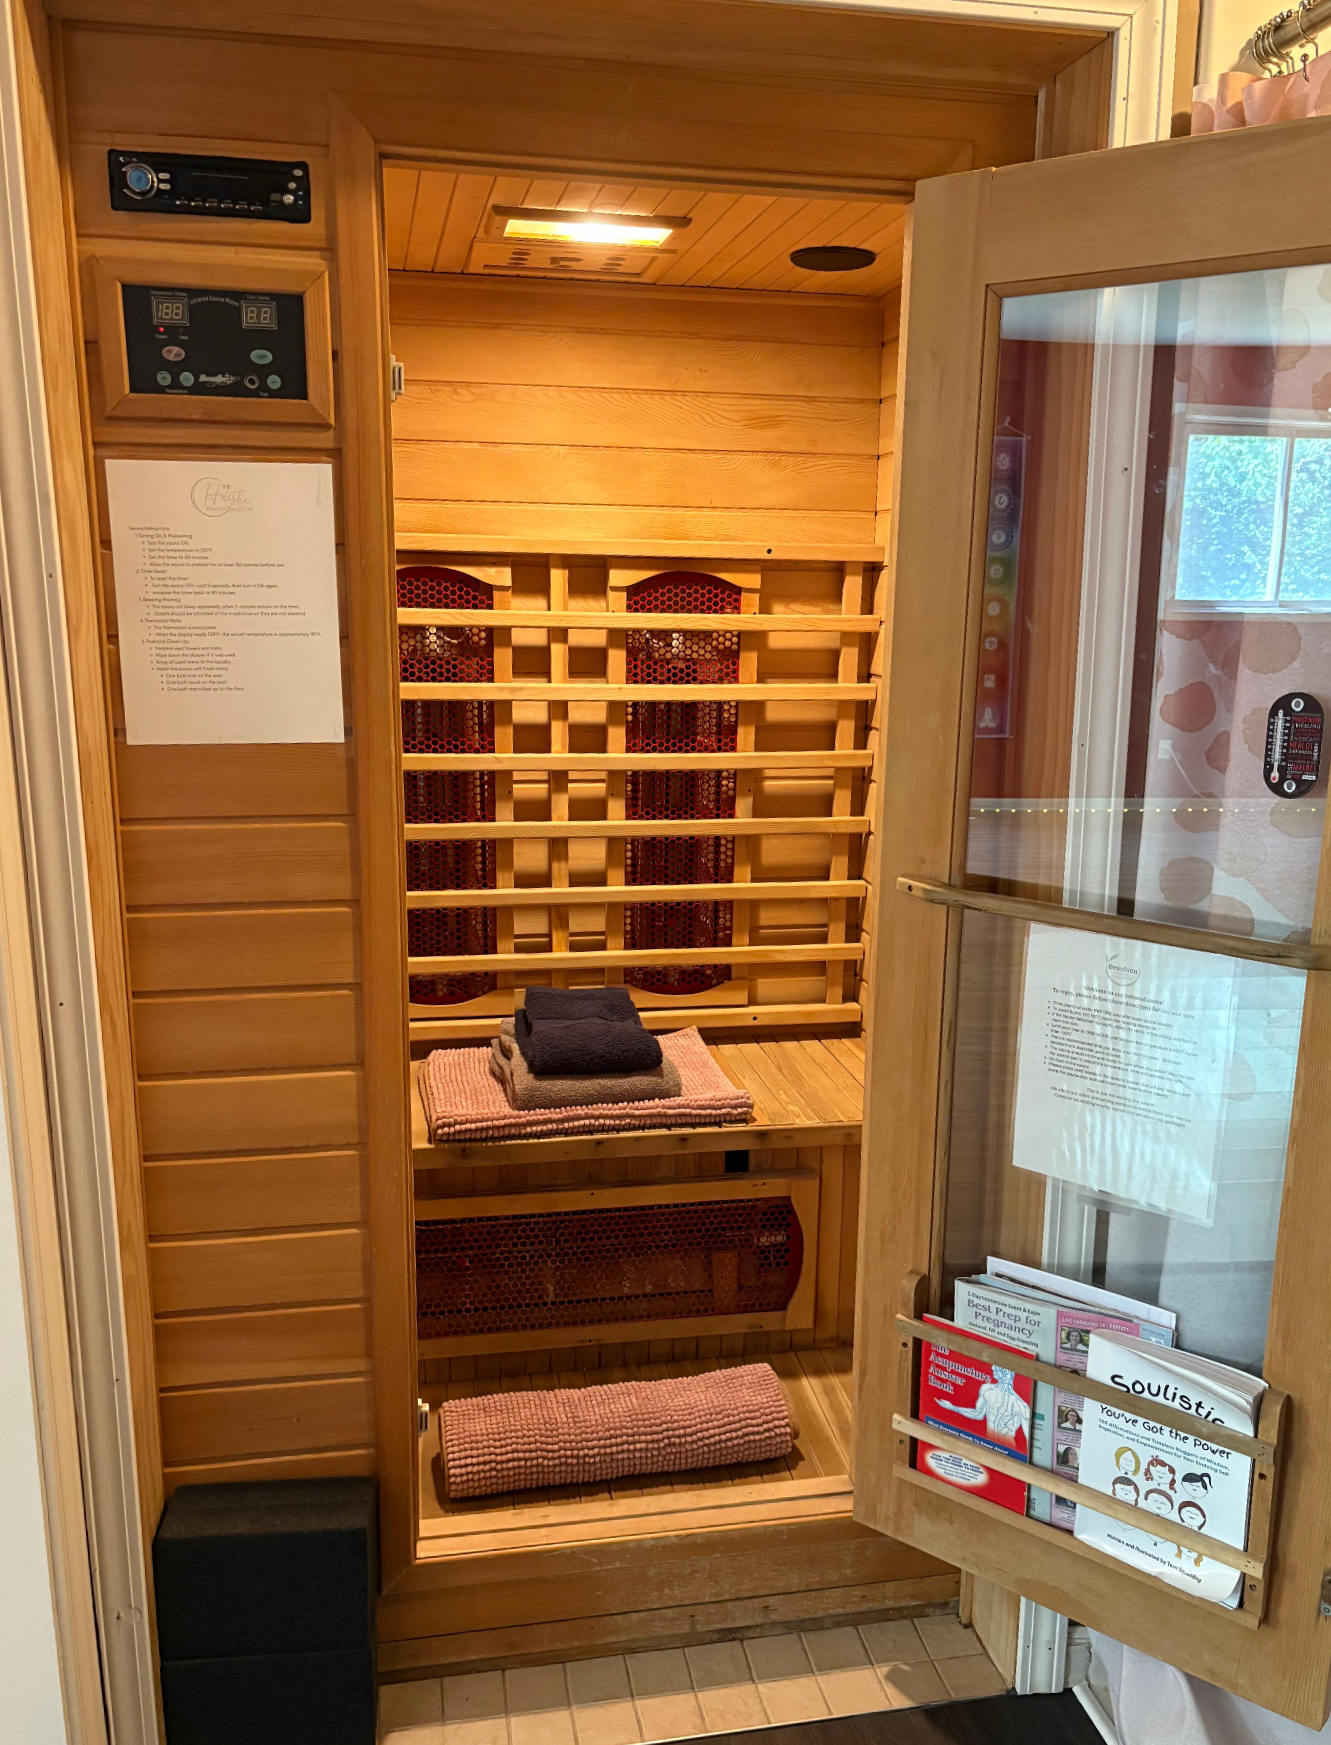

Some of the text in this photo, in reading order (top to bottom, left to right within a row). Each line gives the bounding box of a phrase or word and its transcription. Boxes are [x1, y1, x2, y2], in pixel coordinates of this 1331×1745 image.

[967, 1299, 1042, 1328] Best Prep for
[1008, 1303, 1022, 1312] Event
[974, 1311, 1034, 1338] Pregnancy
[1109, 1324, 1129, 1332] EXPERTS
[1006, 1334, 1016, 1342] Egg
[1017, 1337, 1038, 1348] Freezing
[929, 1352, 991, 1384] Acupuncture
[929, 1364, 966, 1386] Answer
[928, 1374, 954, 1394] Book
[1100, 1404, 1138, 1427] You've
[1142, 1421, 1164, 1436] Got
[1169, 1427, 1189, 1444] the
[940, 1424, 960, 1436] Everyone
[960, 1432, 973, 1442] Needs
[981, 1441, 993, 1449] Know
[994, 1446, 1008, 1454] About
[1108, 1422, 1140, 1438] Affirmations
[1152, 1438, 1175, 1450] Timeless
[1176, 1446, 1198, 1459] Nuggets
[1136, 1438, 1173, 1457] Empowerment
[1183, 1456, 1194, 1464] Your
[1196, 1461, 1218, 1473] Evolving
[1107, 1533, 1124, 1545] Written
[1160, 1557, 1166, 1565] by
